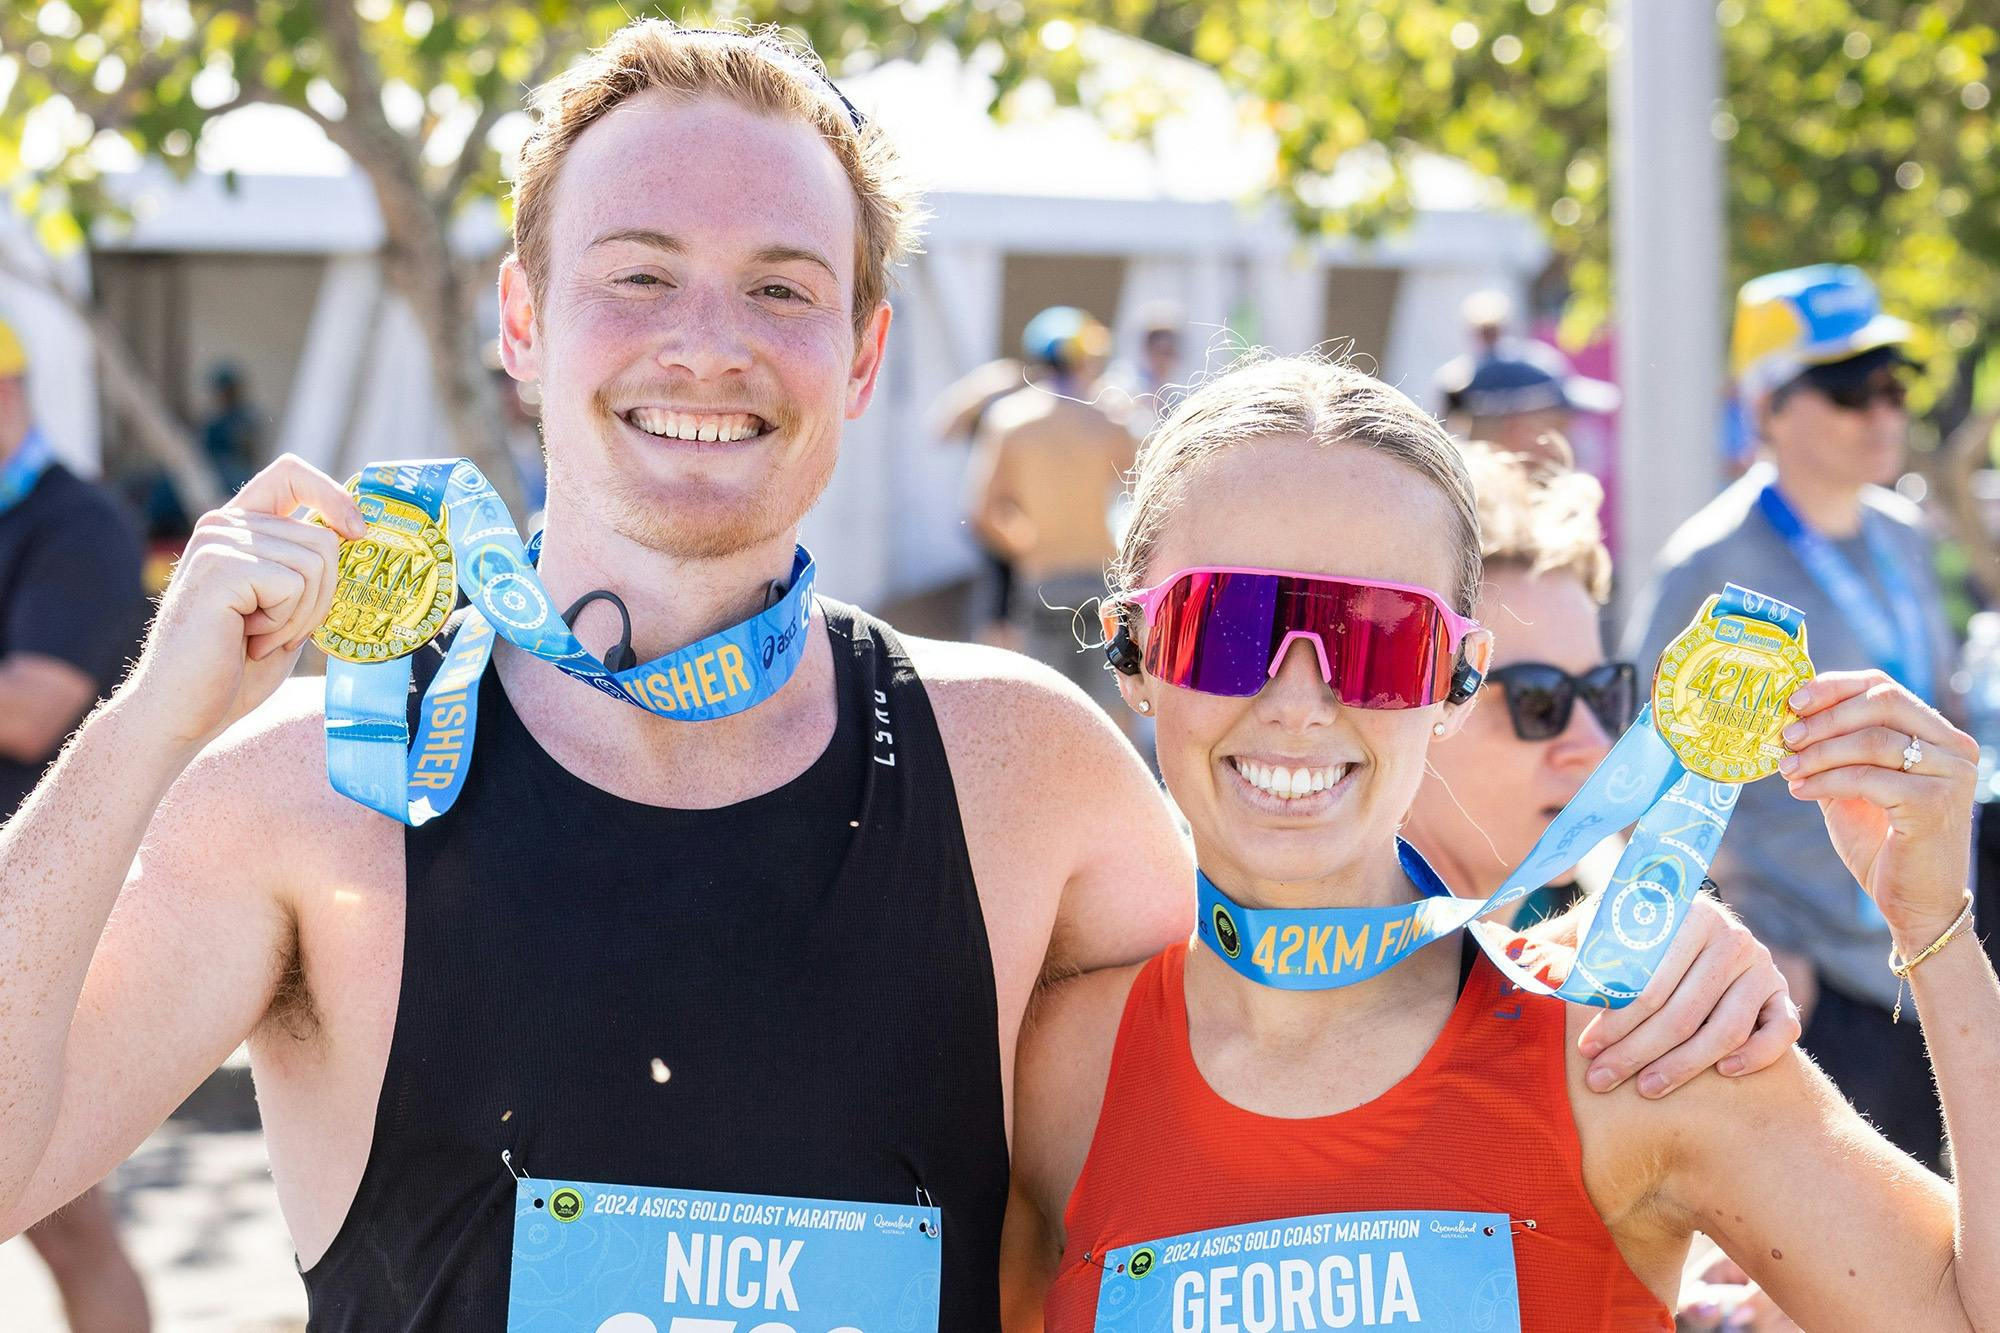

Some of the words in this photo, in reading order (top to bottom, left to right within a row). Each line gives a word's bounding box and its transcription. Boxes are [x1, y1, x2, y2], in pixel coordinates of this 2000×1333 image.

[337, 581, 408, 615] FINISHER
[324, 601, 393, 641] 2024
[1742, 633, 1782, 650] MARATHON
[1685, 657, 1797, 717] 42KM
[1700, 701, 1775, 734] FINISHER
[1694, 722, 1763, 760] 2024
[1251, 924, 1370, 976] 42KM
[593, 1193, 640, 1216] 2024
[640, 1197, 688, 1220] ASICS
[689, 1200, 731, 1223] GOLD
[732, 1203, 783, 1226] COAST
[784, 1208, 867, 1231] MARATHON
[873, 1213, 915, 1230] Queensland
[1429, 1219, 1477, 1235] Queensland
[1162, 1240, 1200, 1265] 2024
[1200, 1233, 1243, 1258] ASICS
[1243, 1227, 1281, 1252] GOLD
[1283, 1223, 1333, 1248] COAST
[1334, 1218, 1421, 1243] MARATHON
[663, 1231, 805, 1311] NICK
[1171, 1250, 1422, 1333] GEORGIA
